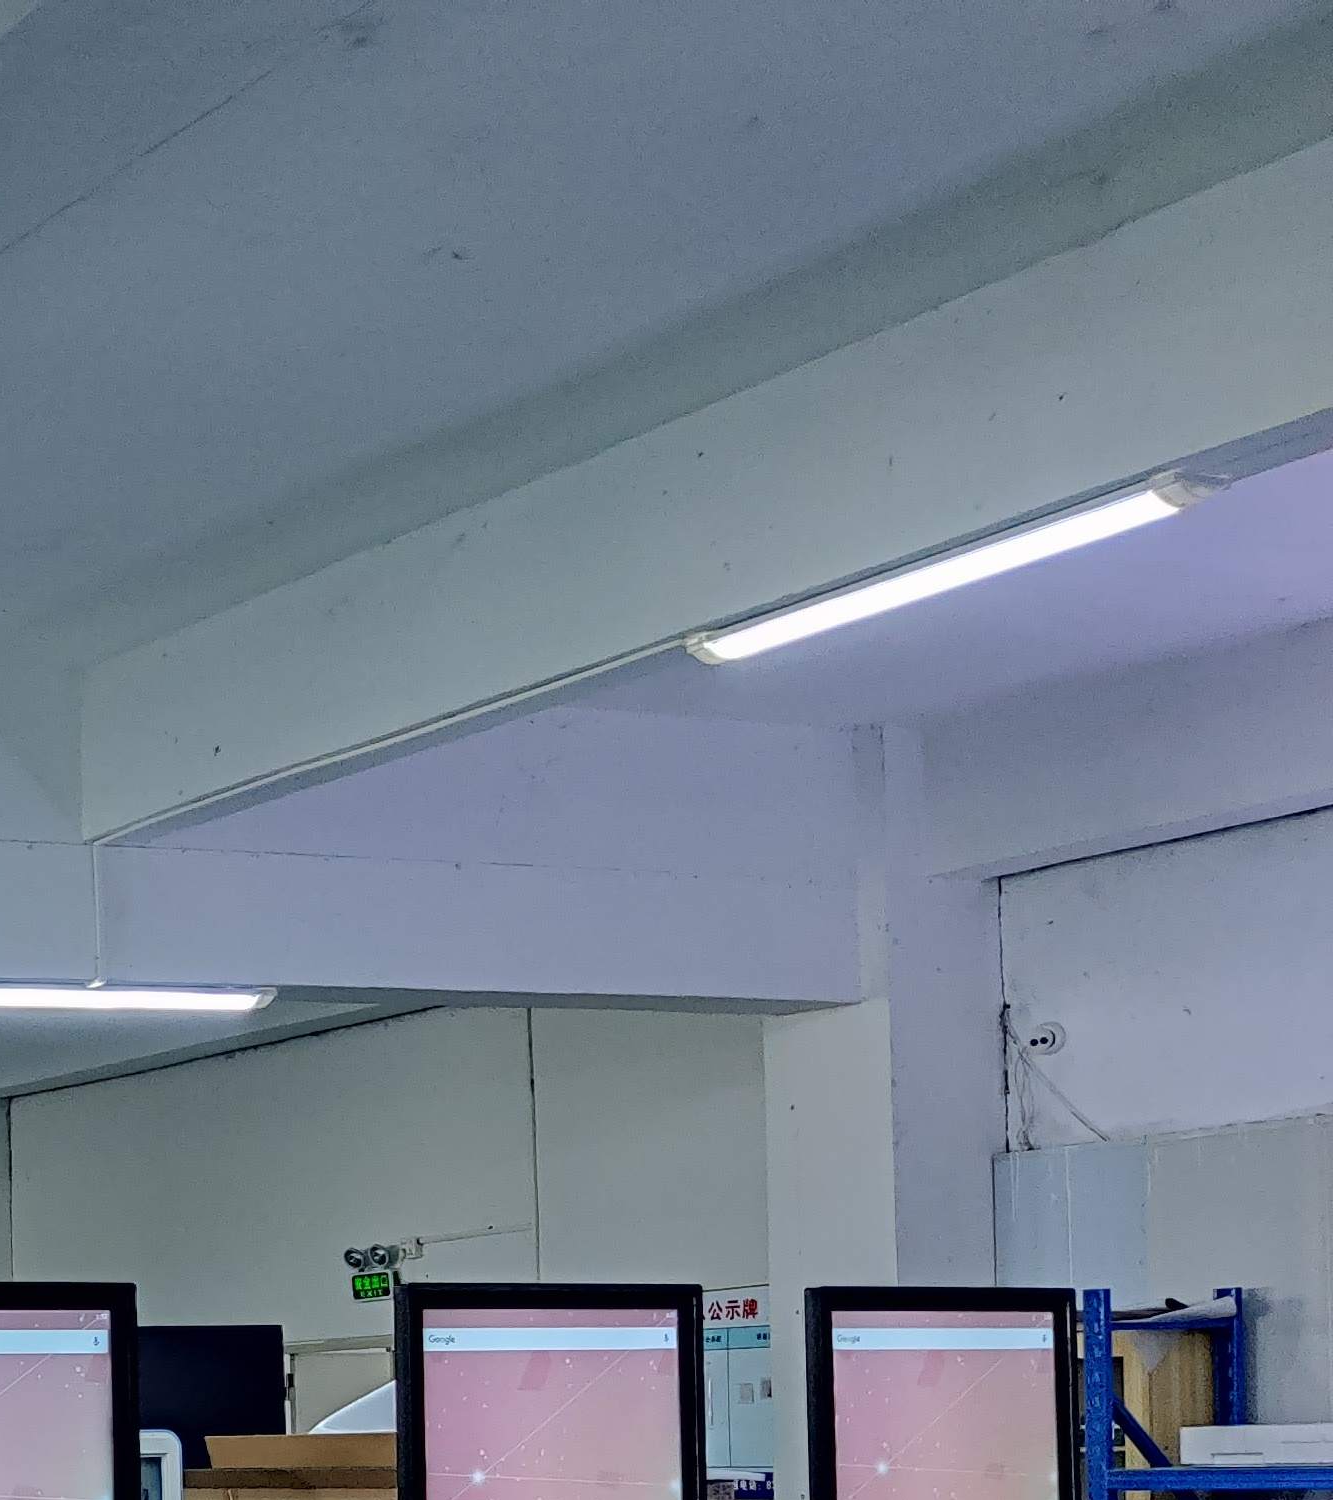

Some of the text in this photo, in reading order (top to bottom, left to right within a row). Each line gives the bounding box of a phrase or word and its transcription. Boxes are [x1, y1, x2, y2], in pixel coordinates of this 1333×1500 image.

[355, 1275, 388, 1290] 安全出口
[360, 1289, 383, 1297] EXIT
[702, 1298, 758, 1320] 公示牌
